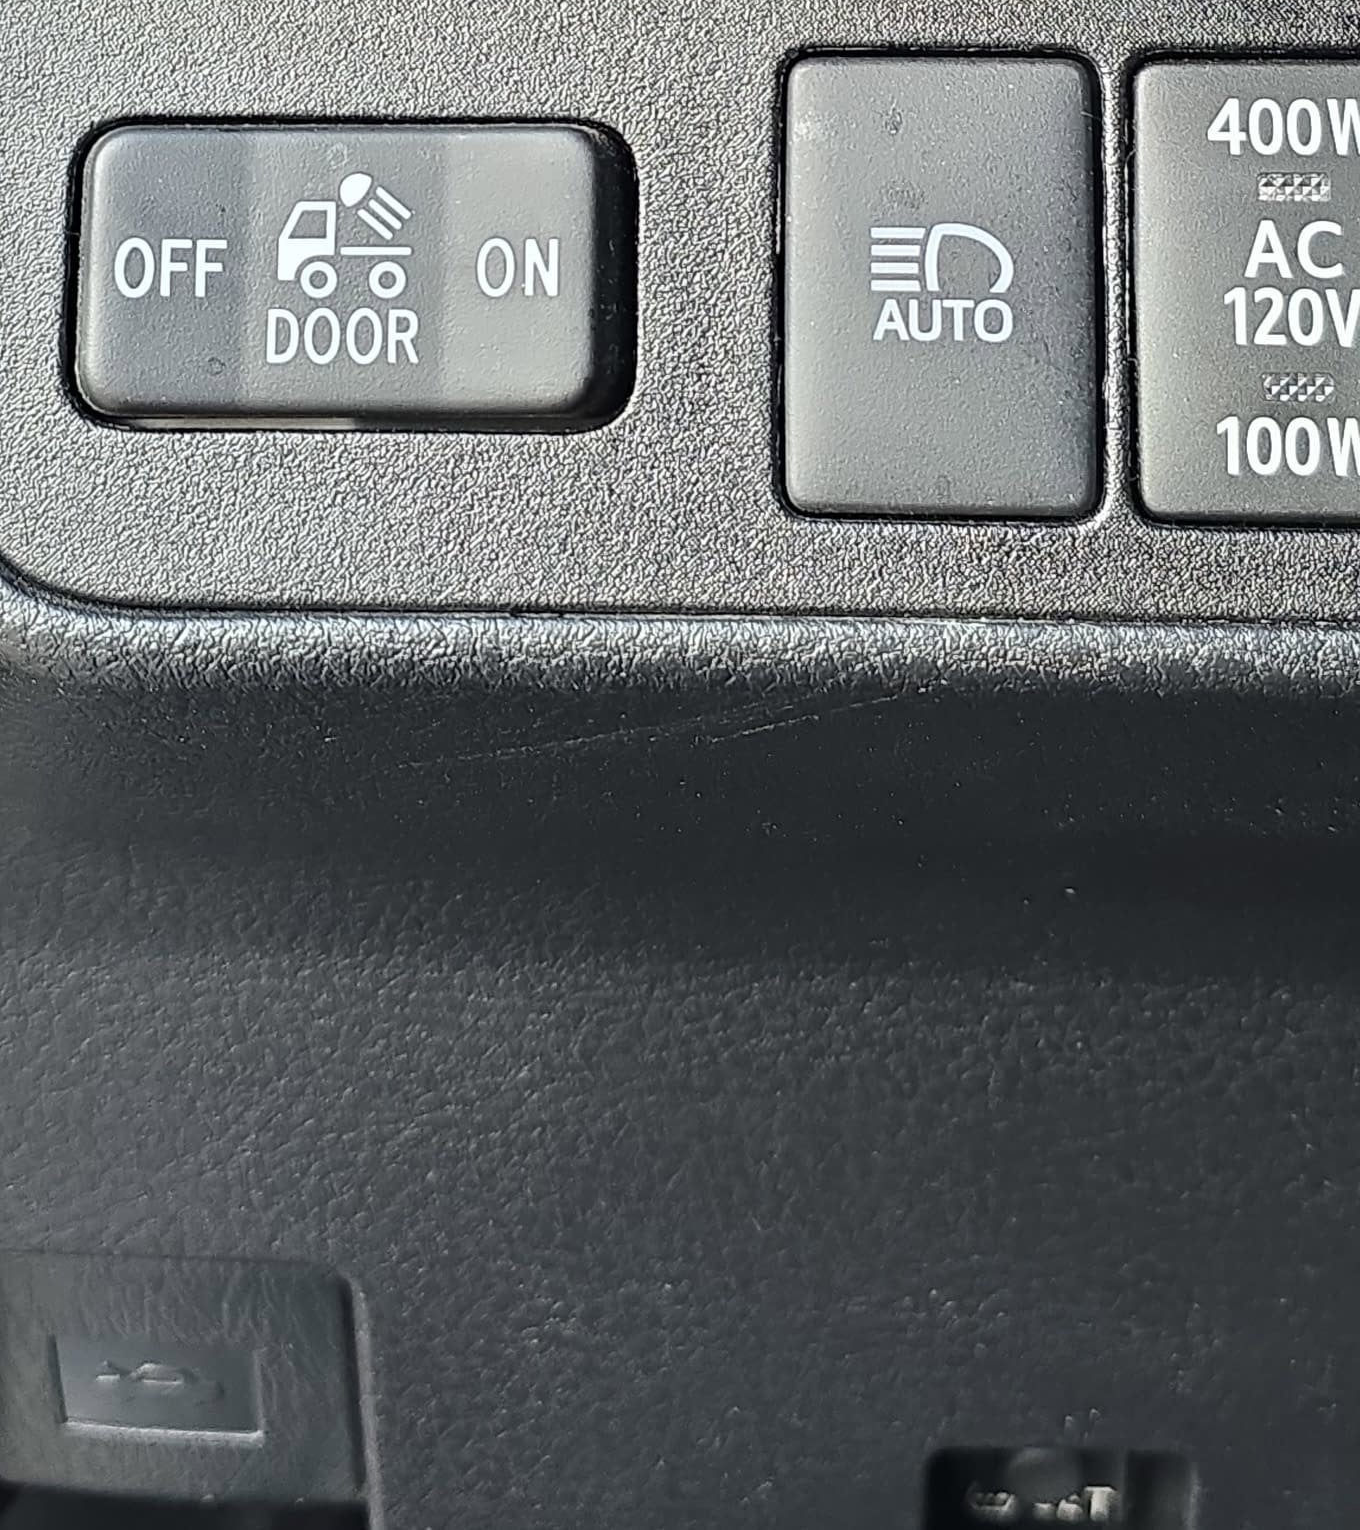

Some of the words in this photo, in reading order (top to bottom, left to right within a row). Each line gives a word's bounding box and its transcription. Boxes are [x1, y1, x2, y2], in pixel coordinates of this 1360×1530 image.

[113, 236, 229, 299] OFF
[475, 237, 560, 298] ON
[1243, 219, 1346, 280] AC
[265, 306, 420, 366] DOOR
[872, 298, 1014, 344] AUTO
